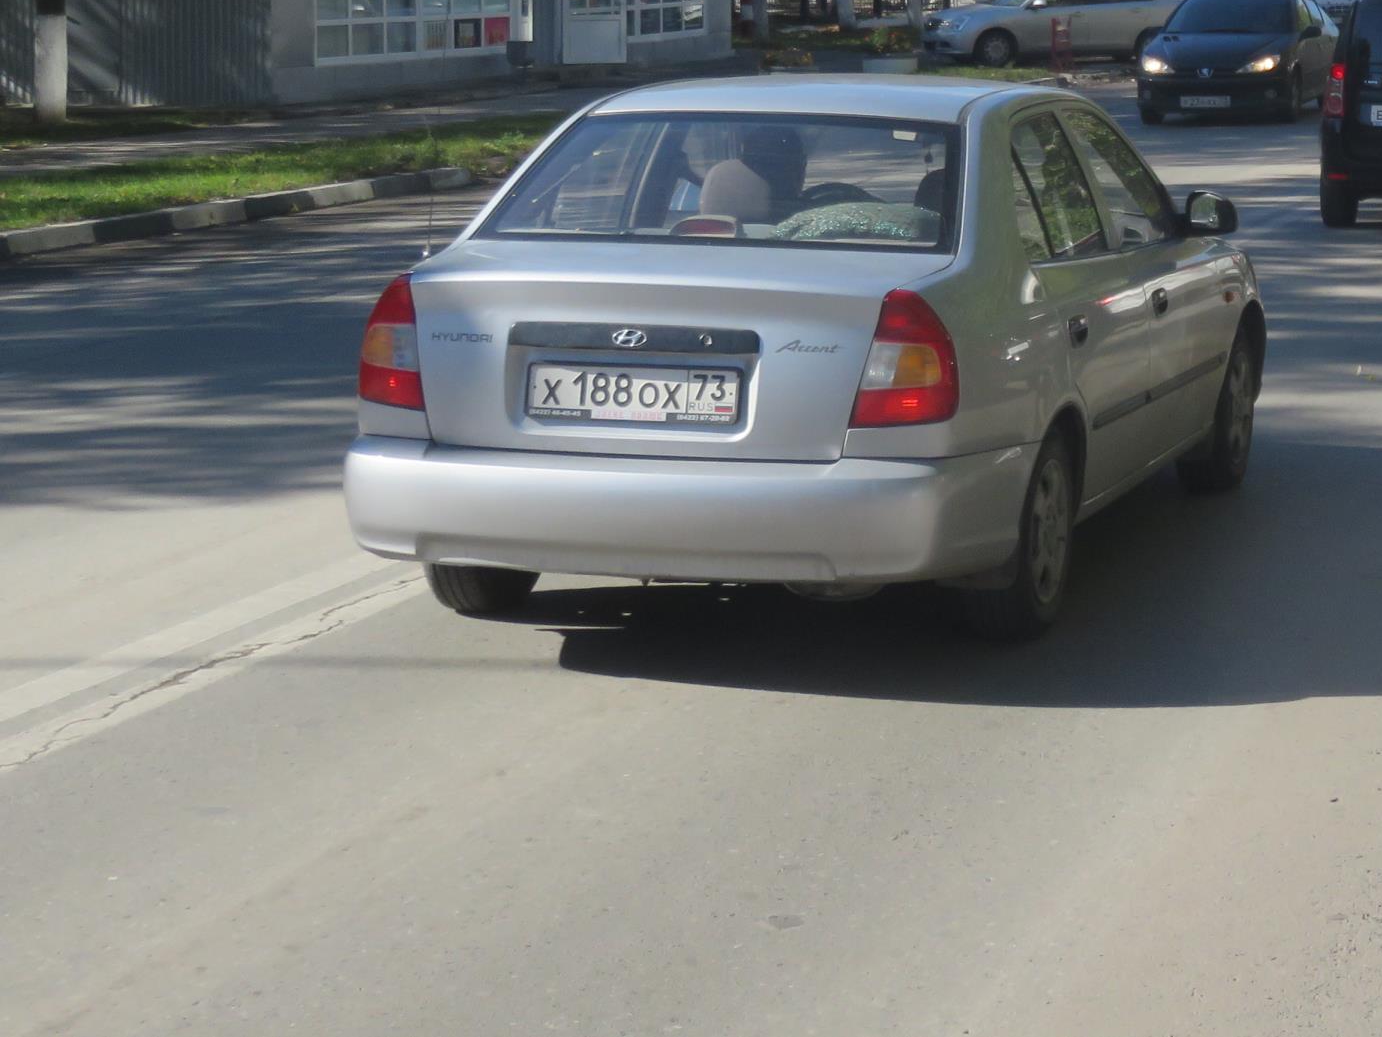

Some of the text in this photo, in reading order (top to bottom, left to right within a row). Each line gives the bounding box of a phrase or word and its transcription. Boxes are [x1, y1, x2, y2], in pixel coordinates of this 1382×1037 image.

[431, 331, 494, 343] HYUNDAI
[775, 340, 844, 353] Accent
[542, 371, 727, 410] Х188ОХ 73
[689, 402, 714, 412] RUS
